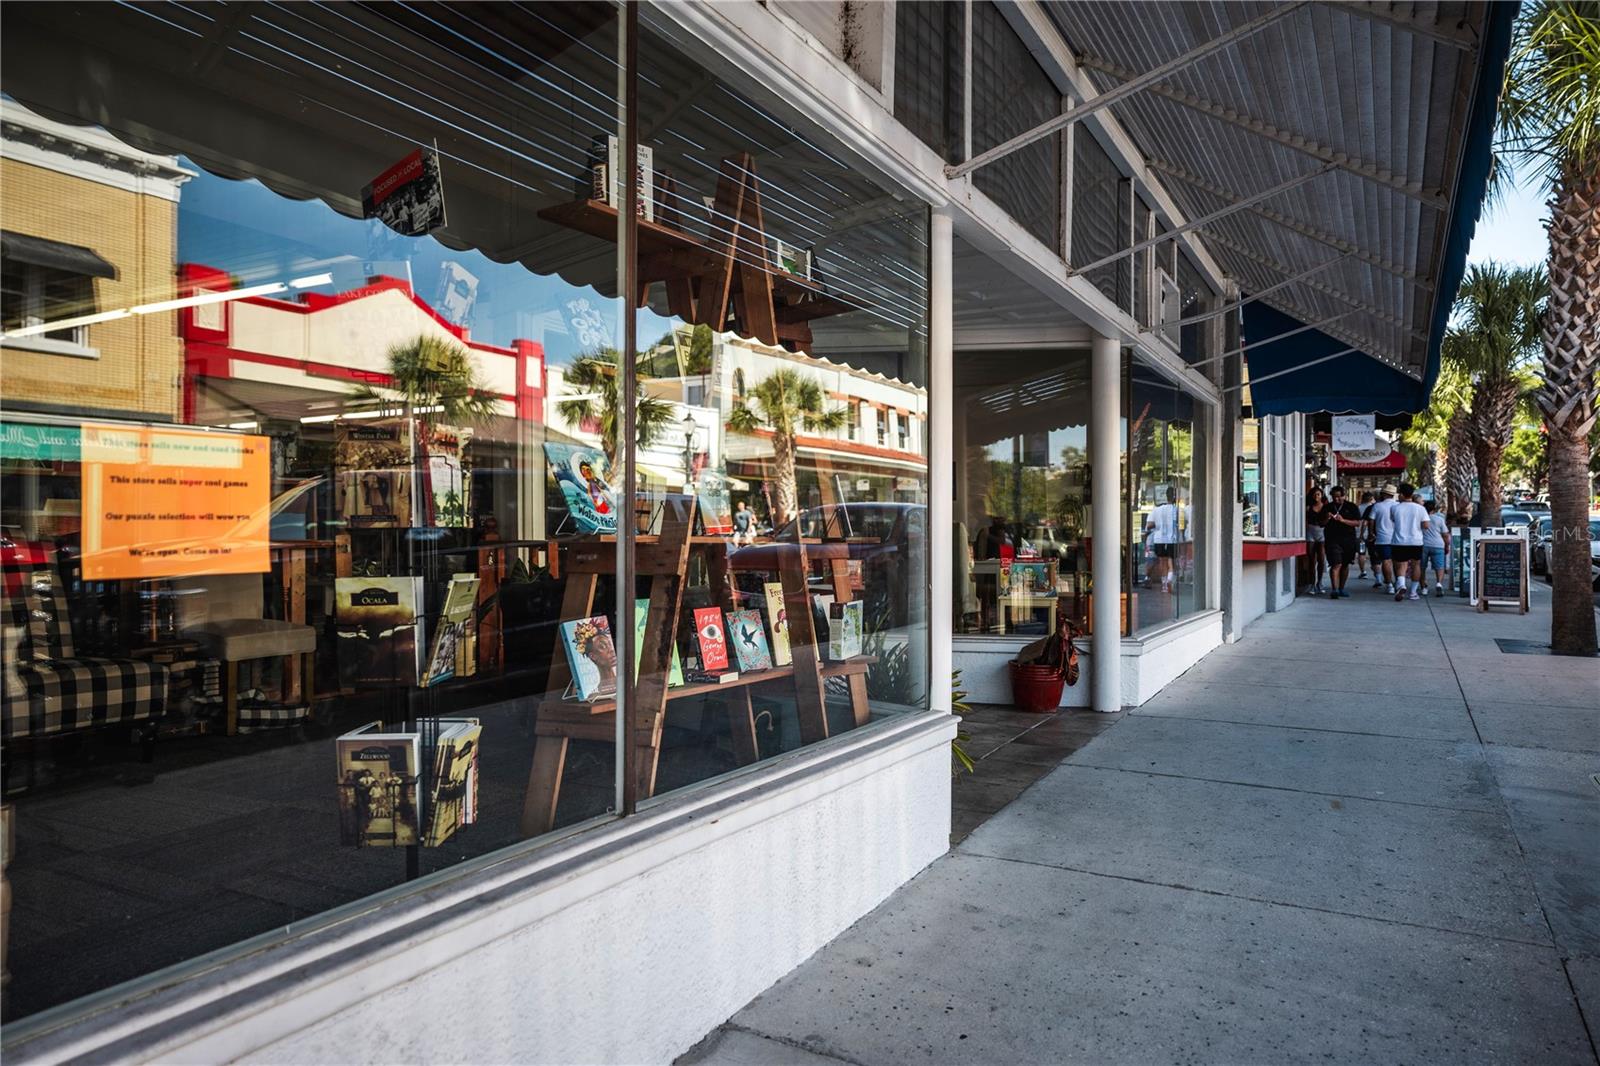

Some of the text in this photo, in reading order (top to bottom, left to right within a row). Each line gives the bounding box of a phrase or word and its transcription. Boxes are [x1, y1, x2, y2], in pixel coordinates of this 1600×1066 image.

[151, 441, 170, 450] sells
[173, 443, 190, 451] new
[193, 443, 209, 452] and
[211, 444, 229, 454] used
[110, 475, 248, 489] This store sells super cool games
[105, 512, 123, 521] Our
[125, 512, 156, 521] puzzle
[158, 512, 196, 521] selection
[198, 513, 214, 521] will
[699, 614, 721, 625] 1984
